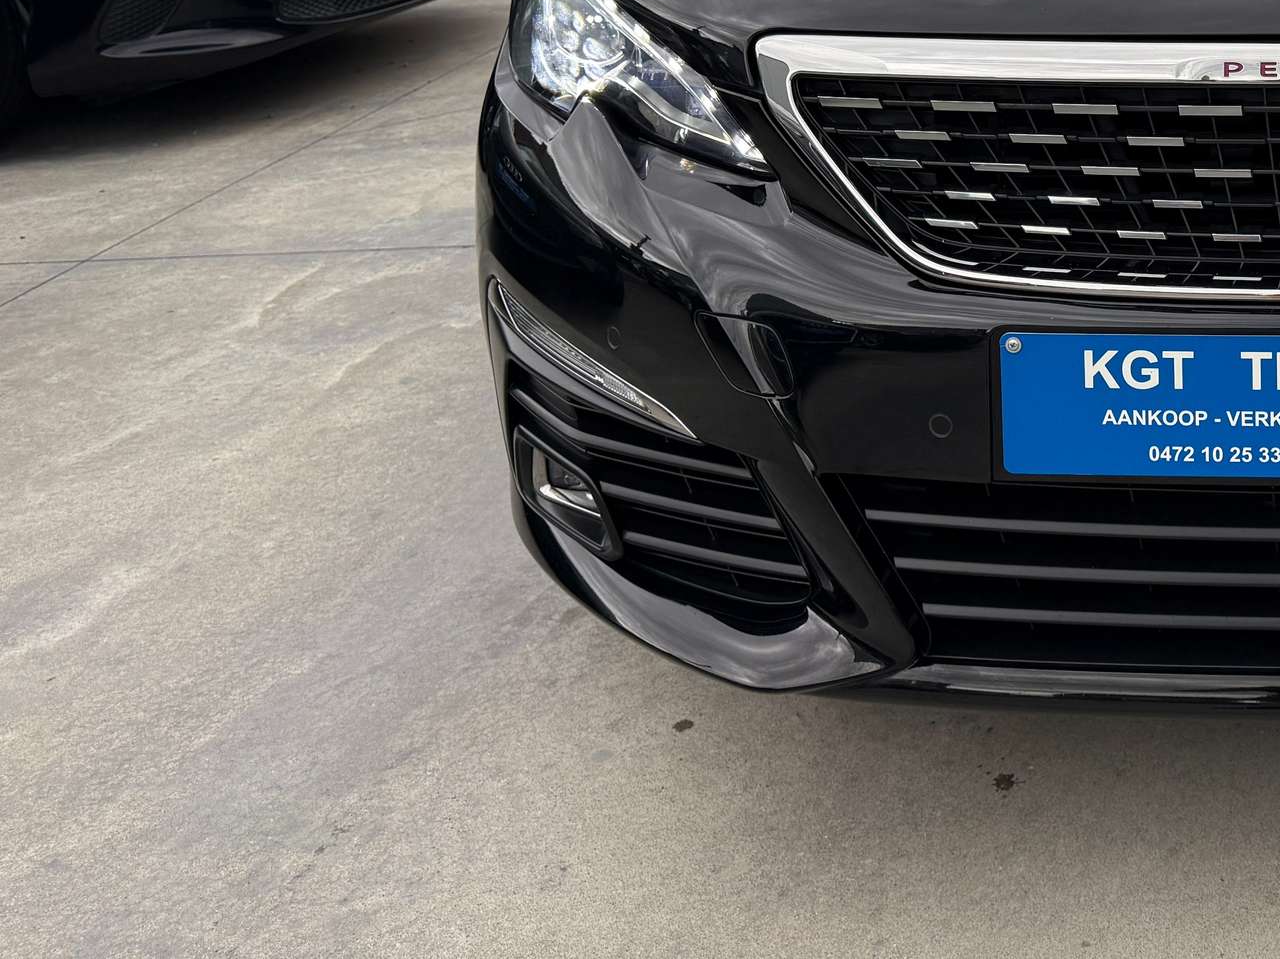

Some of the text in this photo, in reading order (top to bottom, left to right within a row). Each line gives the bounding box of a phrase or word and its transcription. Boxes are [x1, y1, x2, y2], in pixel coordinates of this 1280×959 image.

[1083, 349, 1195, 390] KGT
[1102, 409, 1208, 427] AANKOOP
[1148, 445, 1195, 462] 0472
[1202, 446, 1224, 463] 10
[1229, 446, 1253, 463] 25
